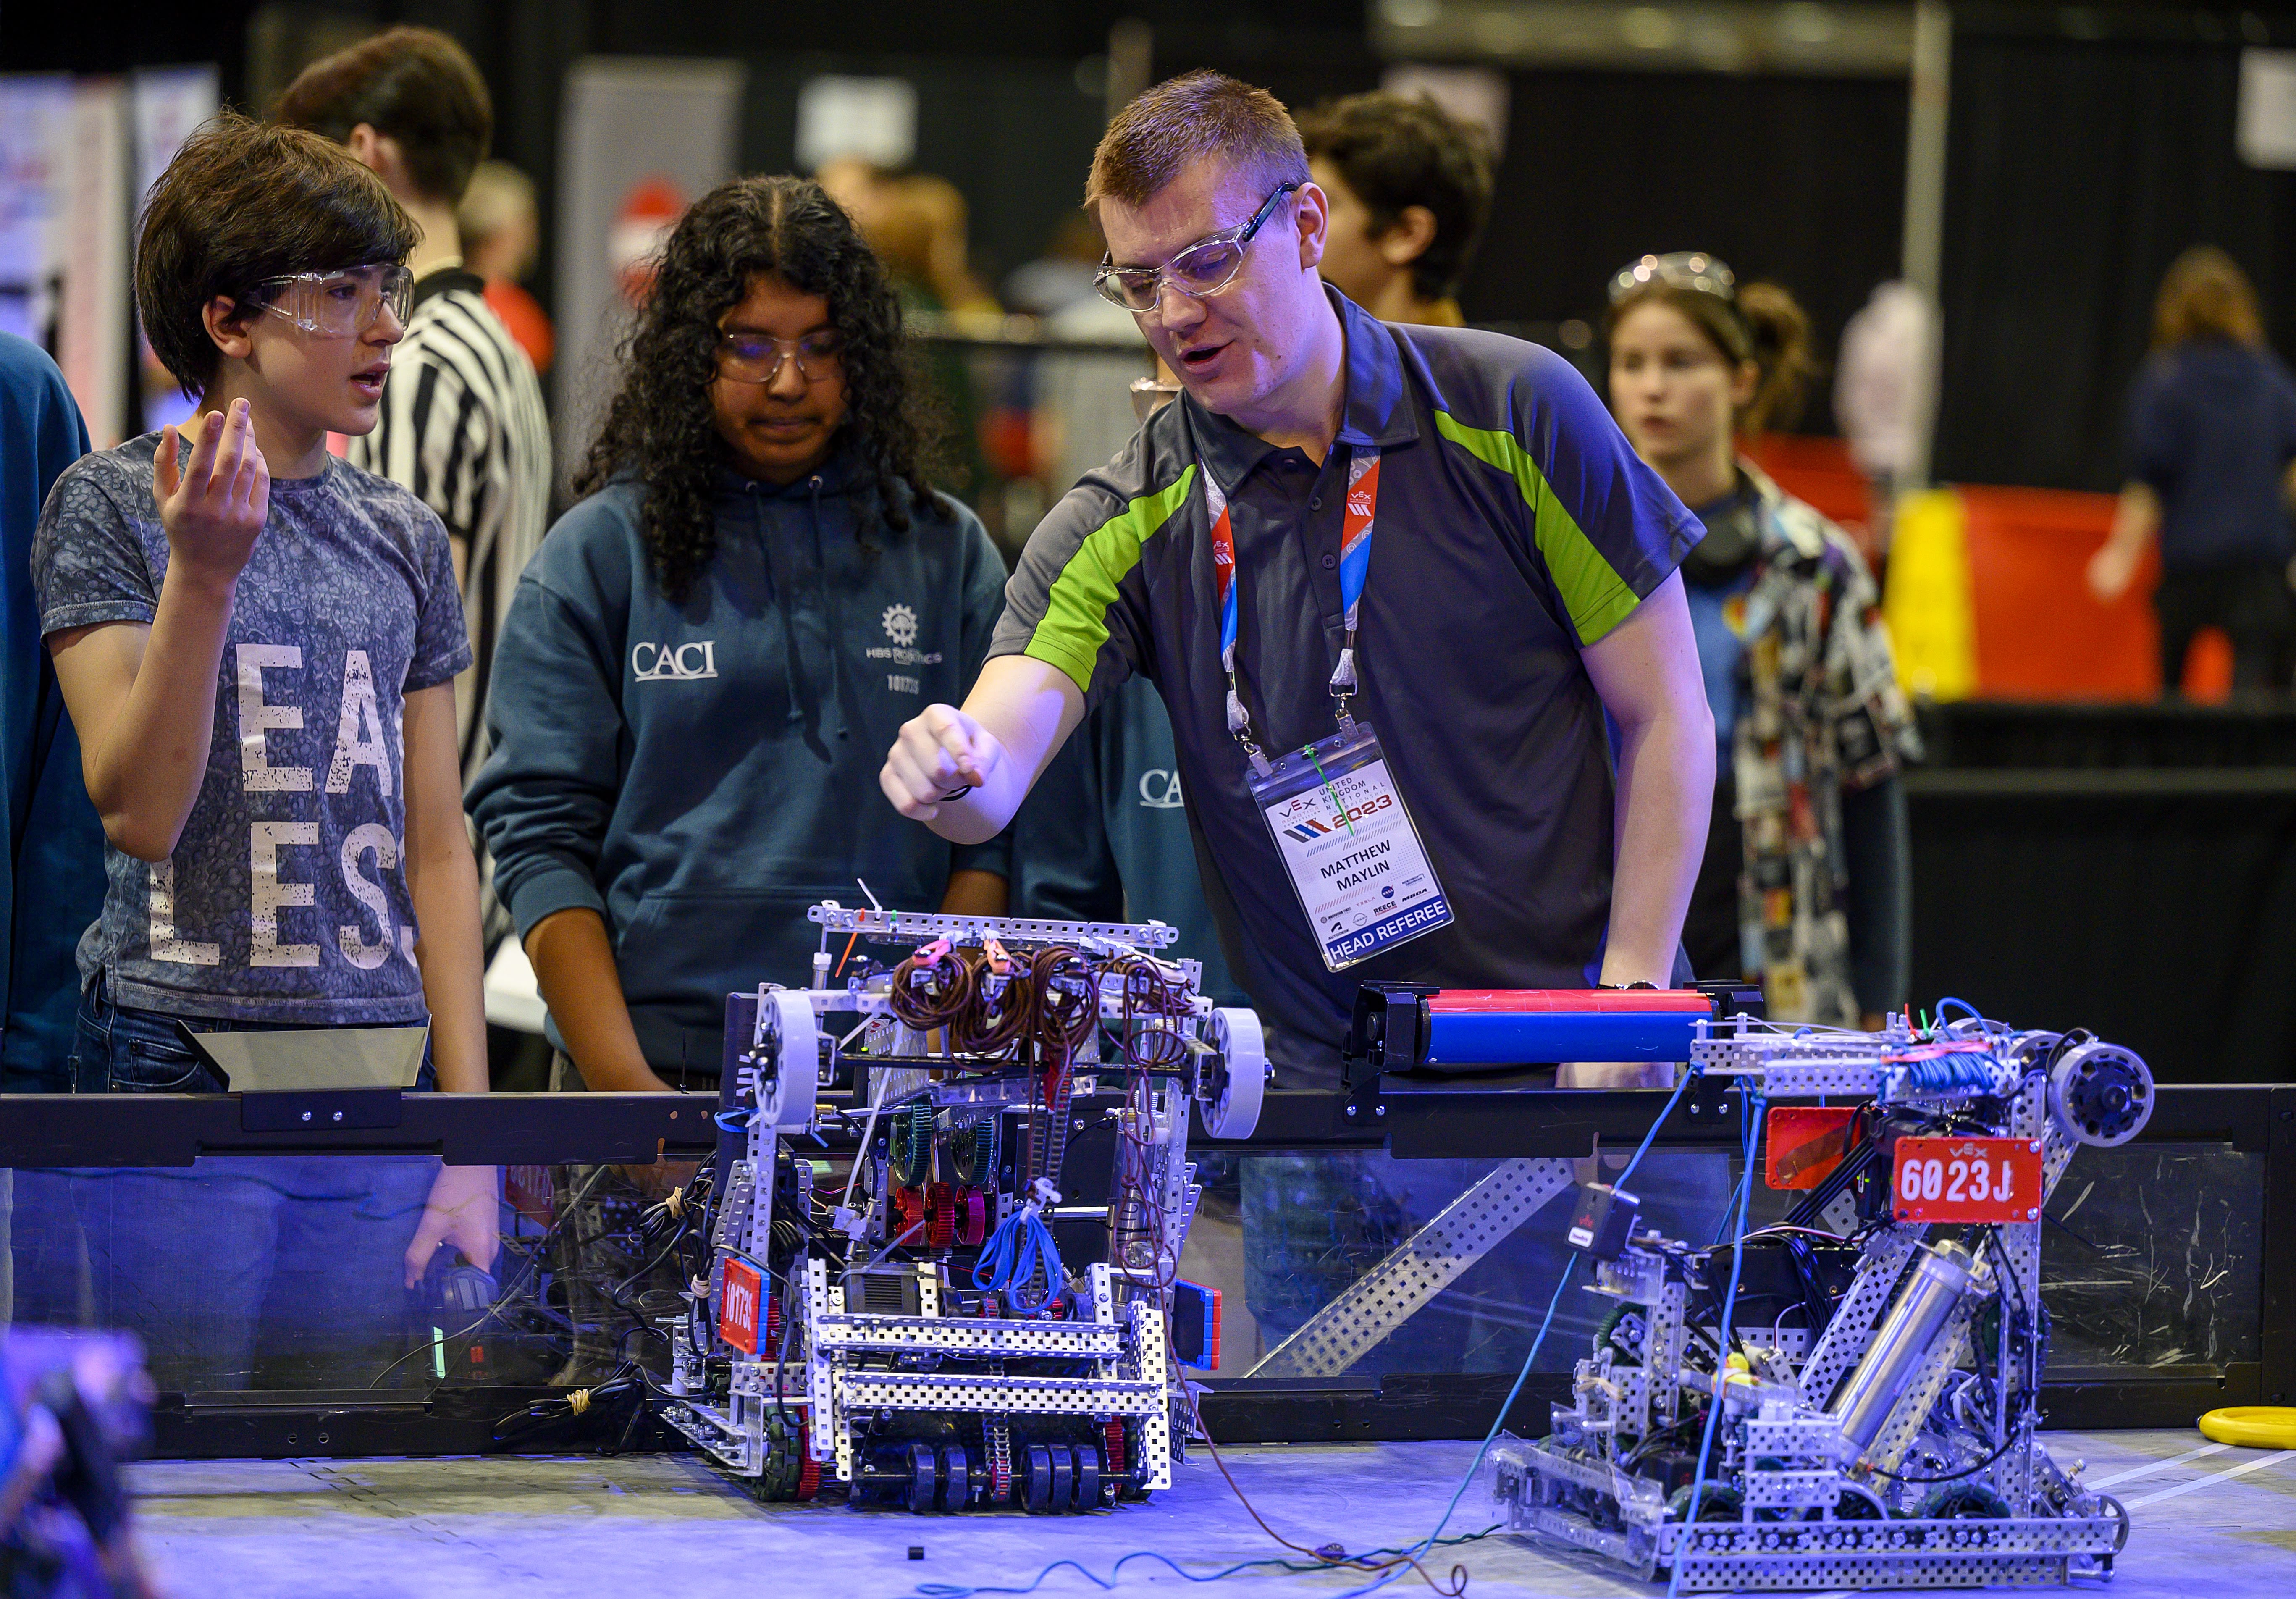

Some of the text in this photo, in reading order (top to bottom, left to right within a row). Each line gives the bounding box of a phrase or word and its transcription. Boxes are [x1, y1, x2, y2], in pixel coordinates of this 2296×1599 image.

[1351, 491, 1371, 500] VEX
[632, 641, 716, 678] CACI
[1139, 769, 1183, 803] CA
[1319, 777, 1352, 795] UNITED
[1279, 798, 1316, 817] VEX
[1329, 788, 1386, 816] CHMPIONSHIP
[1332, 794, 1393, 829] 2023
[1320, 840, 1390, 879] MATTHEW
[1336, 860, 1390, 891] MAYLIN
[1373, 901, 1396, 914] REECE
[1328, 928, 1349, 940] AUTODESK
[1330, 901, 1446, 960] HEAD REFEREE
[1949, 1142, 1988, 1158] VEX
[1901, 1158, 2013, 1202] 6023J
